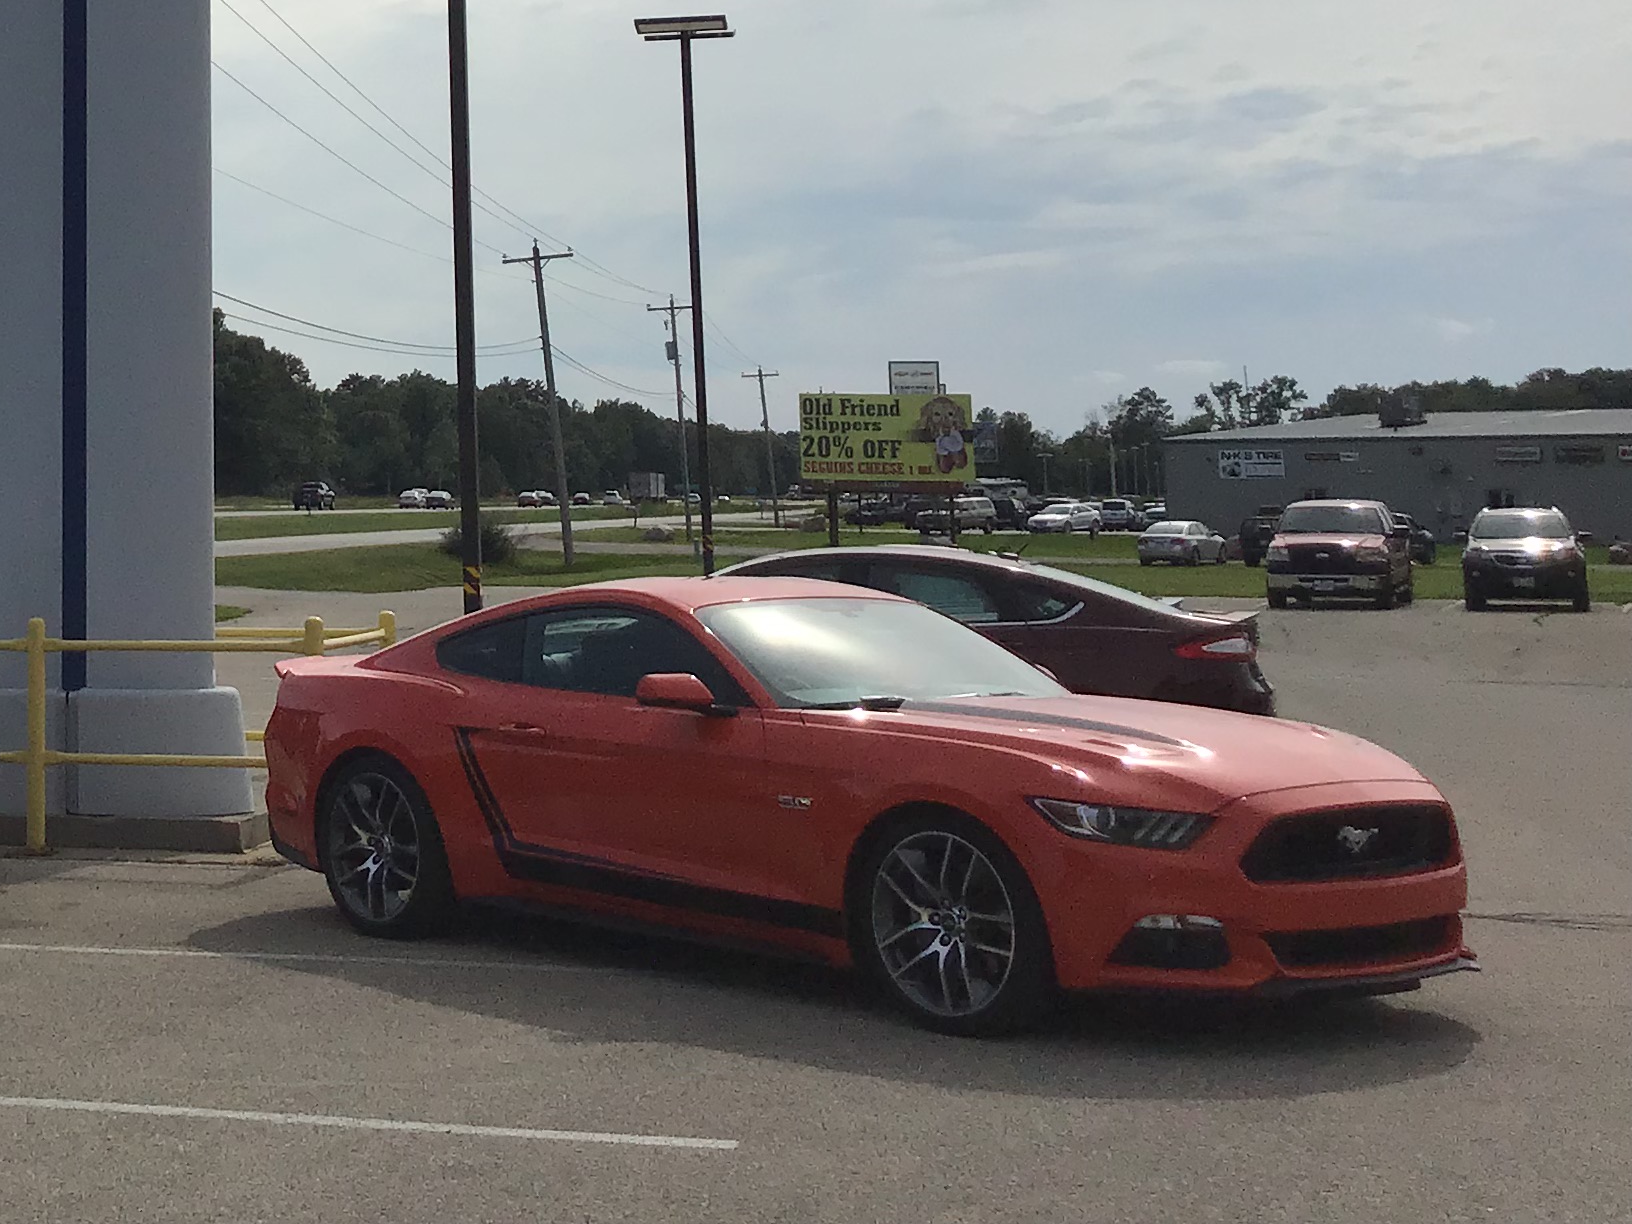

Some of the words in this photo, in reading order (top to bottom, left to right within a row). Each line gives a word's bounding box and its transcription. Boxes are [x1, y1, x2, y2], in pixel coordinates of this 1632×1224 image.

[802, 397, 833, 417] Old
[839, 398, 901, 417] Friend
[802, 417, 882, 433] Slippers
[802, 435, 854, 459] 20%
[862, 440, 902, 459] OFF
[1255, 451, 1283, 460] TIRE
[803, 460, 854, 474] SEGUINS
[858, 462, 905, 475] CHEESE
